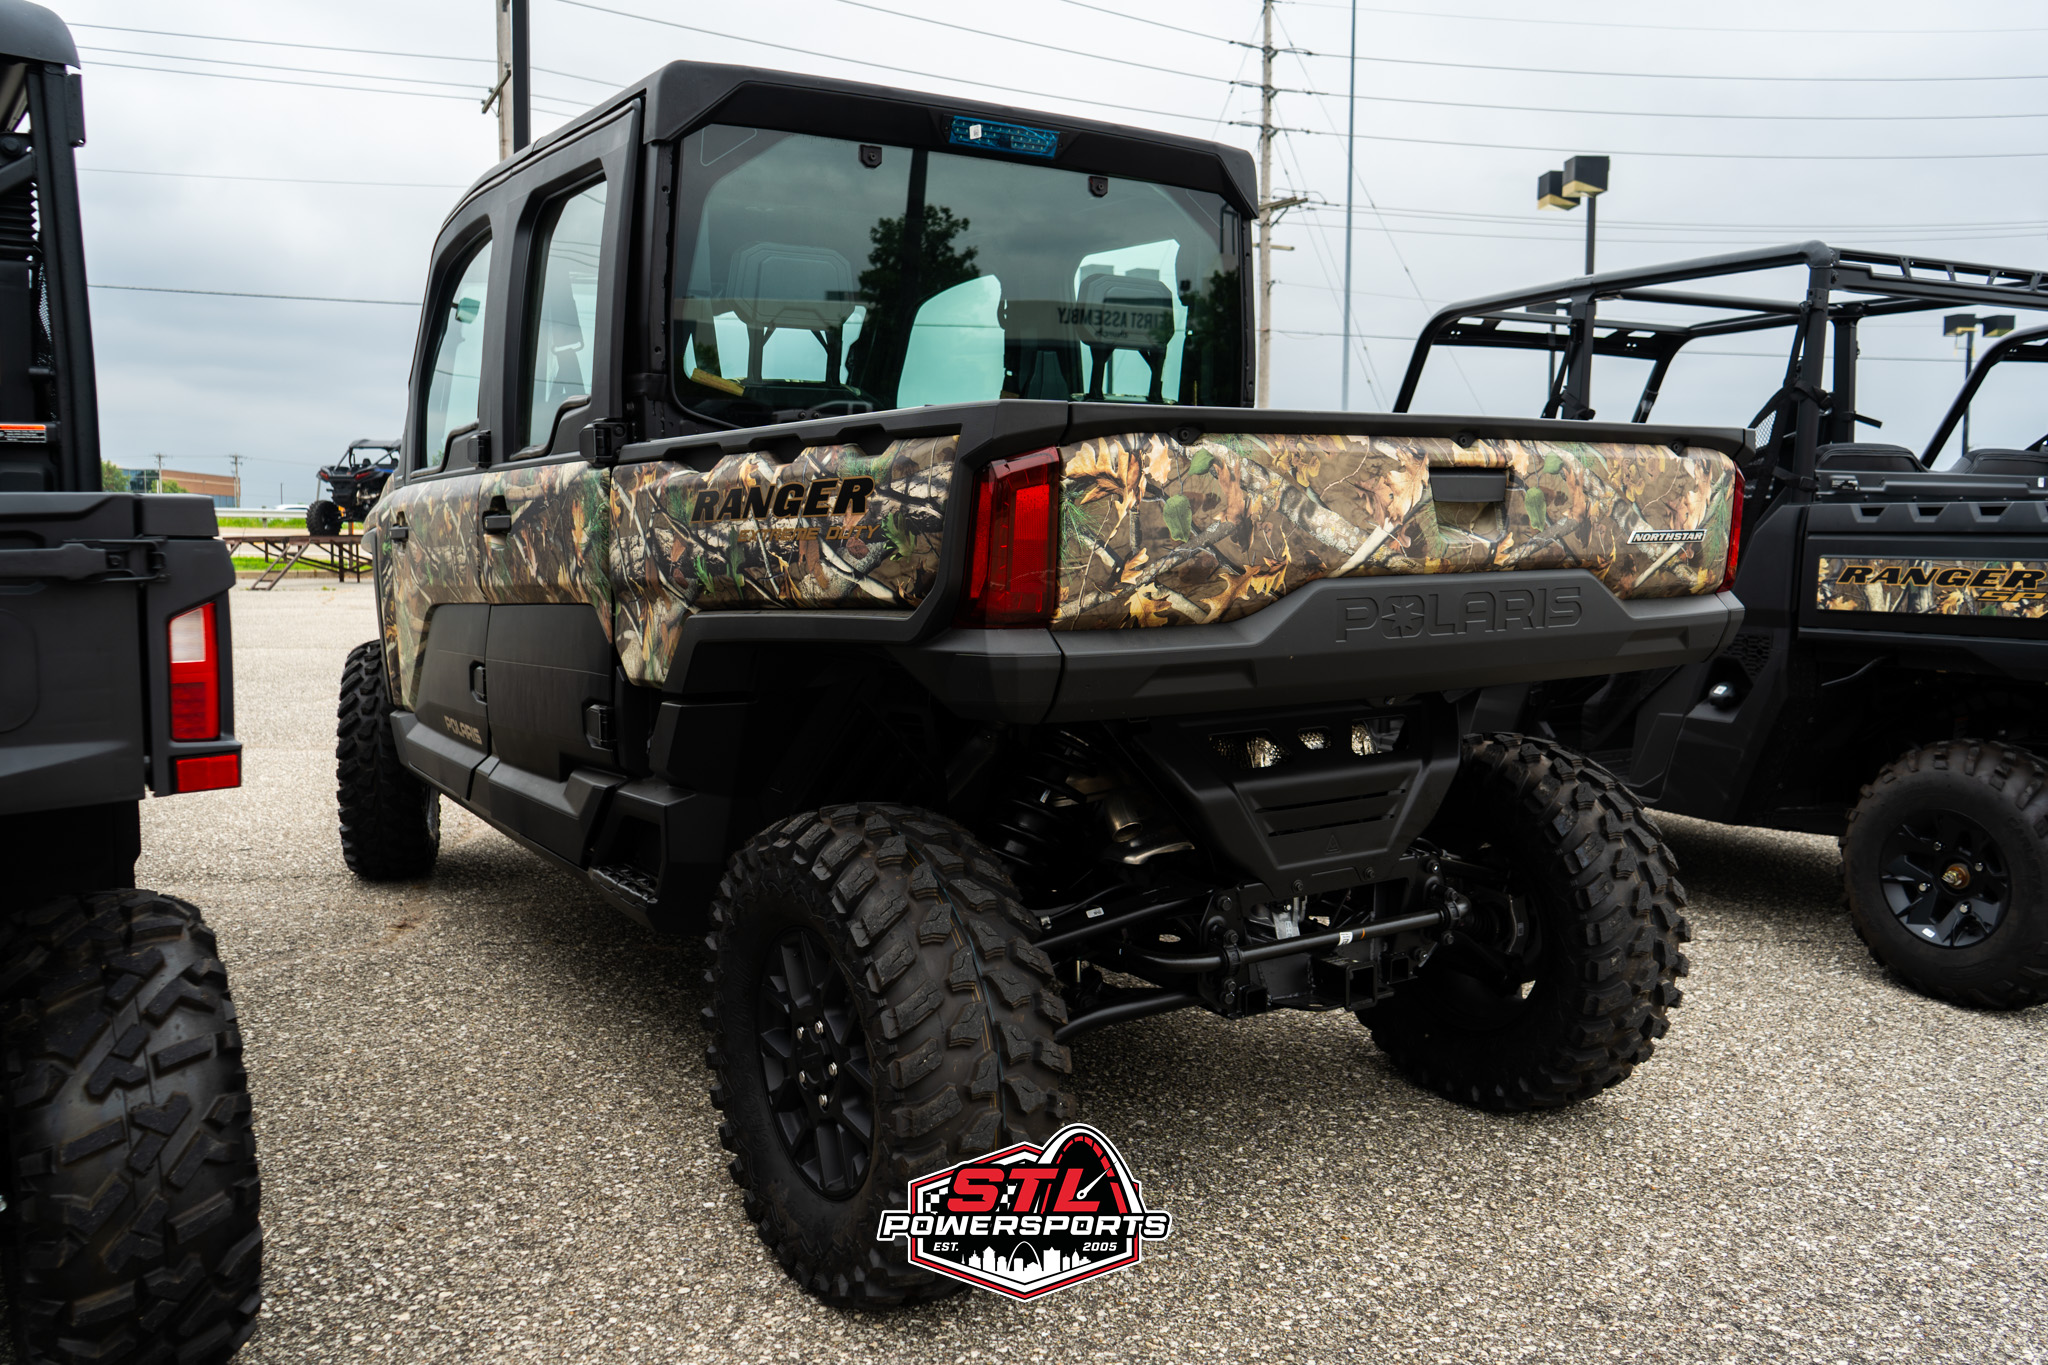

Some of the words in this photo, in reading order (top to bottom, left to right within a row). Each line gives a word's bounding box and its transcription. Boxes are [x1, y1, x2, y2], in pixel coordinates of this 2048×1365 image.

[690, 475, 875, 524] RANGER
[737, 526, 820, 543] EXTREME
[826, 524, 881, 541] DUTY
[1631, 531, 1705, 543] NORTHSTAR
[1836, 565, 2047, 590] RANGER
[1977, 590, 2048, 602] SP
[1335, 587, 1583, 643] POLARIS
[443, 715, 483, 745] POLARIS
